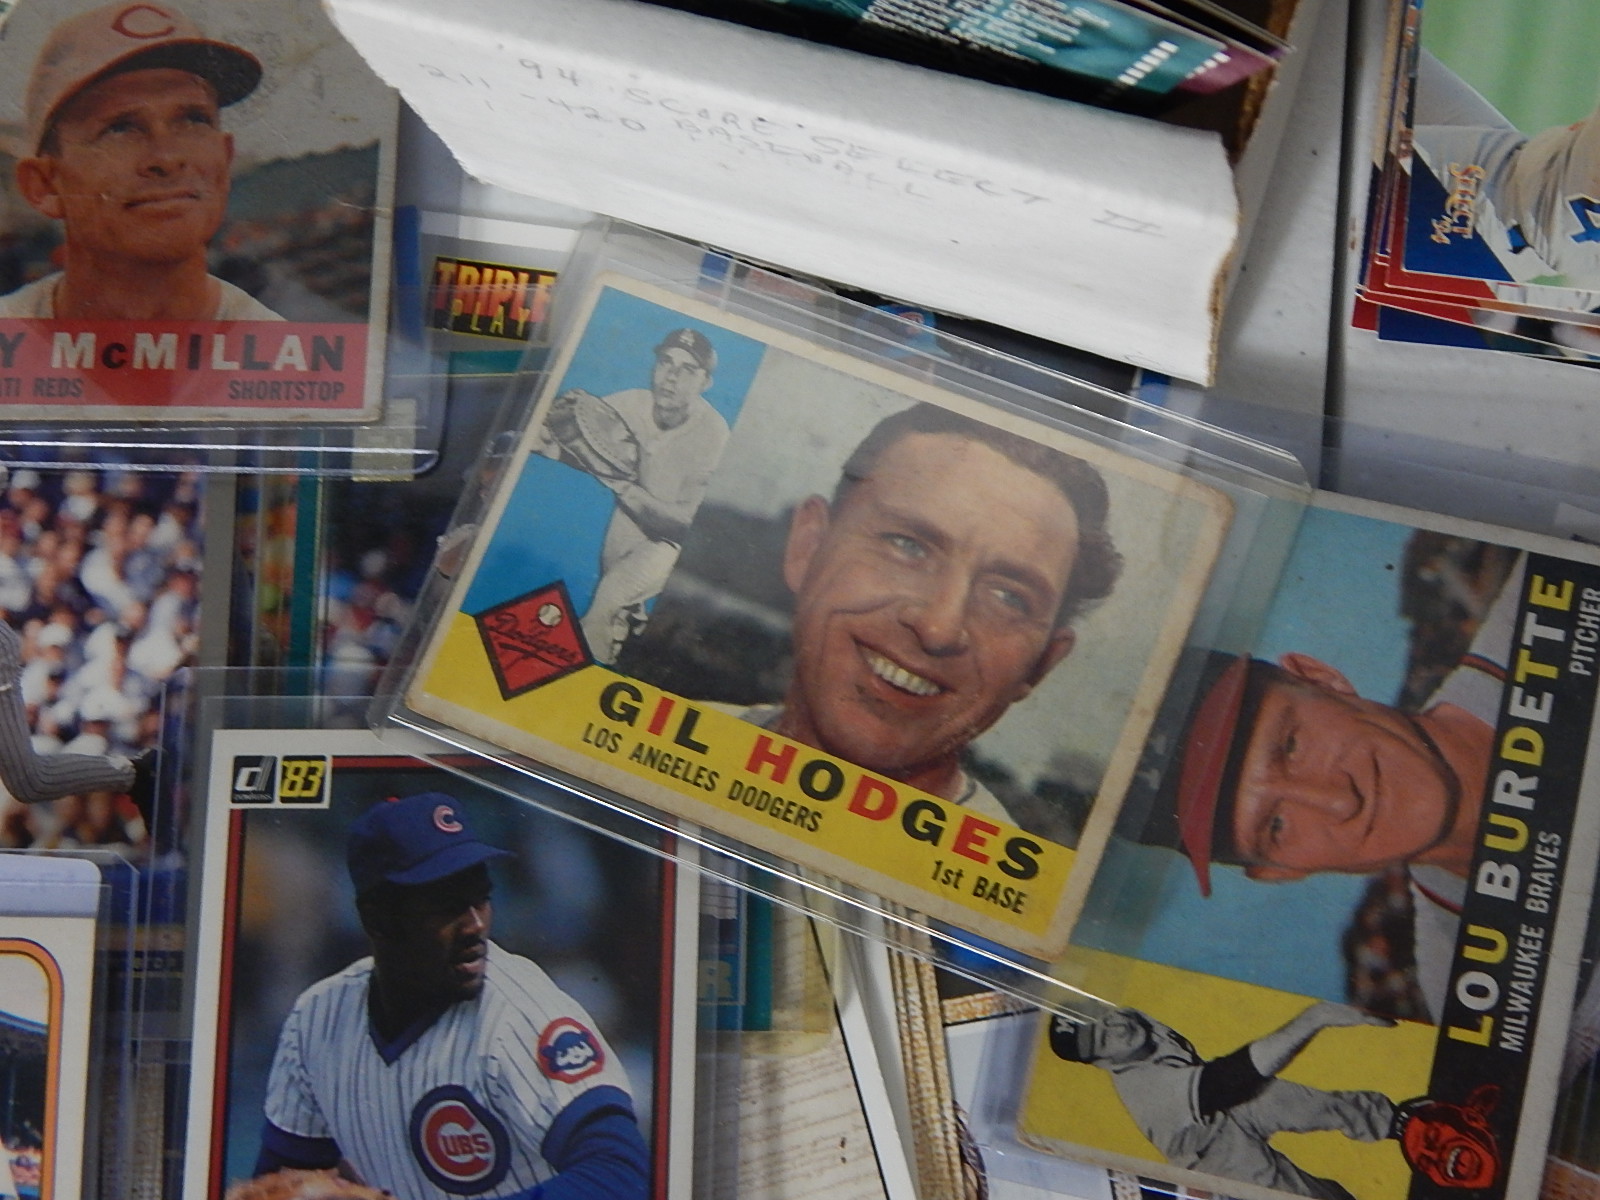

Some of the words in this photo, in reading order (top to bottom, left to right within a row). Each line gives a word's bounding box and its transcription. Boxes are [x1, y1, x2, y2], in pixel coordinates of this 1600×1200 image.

[32, 377, 83, 399] REDS
[228, 379, 345, 402] SHORTSTOP
[1568, 587, 1600, 676] PITCHER
[582, 722, 623, 754] LOS
[628, 741, 720, 793] ANGELES
[727, 779, 824, 832] DODGERS
[599, 681, 709, 755] GIL
[745, 734, 1044, 881] HODGES
[1475, 574, 1575, 902] BURDETTE
[931, 859, 963, 890] 1st
[973, 876, 1027, 915] BASE
[1499, 923, 1546, 1053] MILWAUKEE
[1525, 830, 1562, 914] BRAVES
[1447, 923, 1509, 1048] LOU
